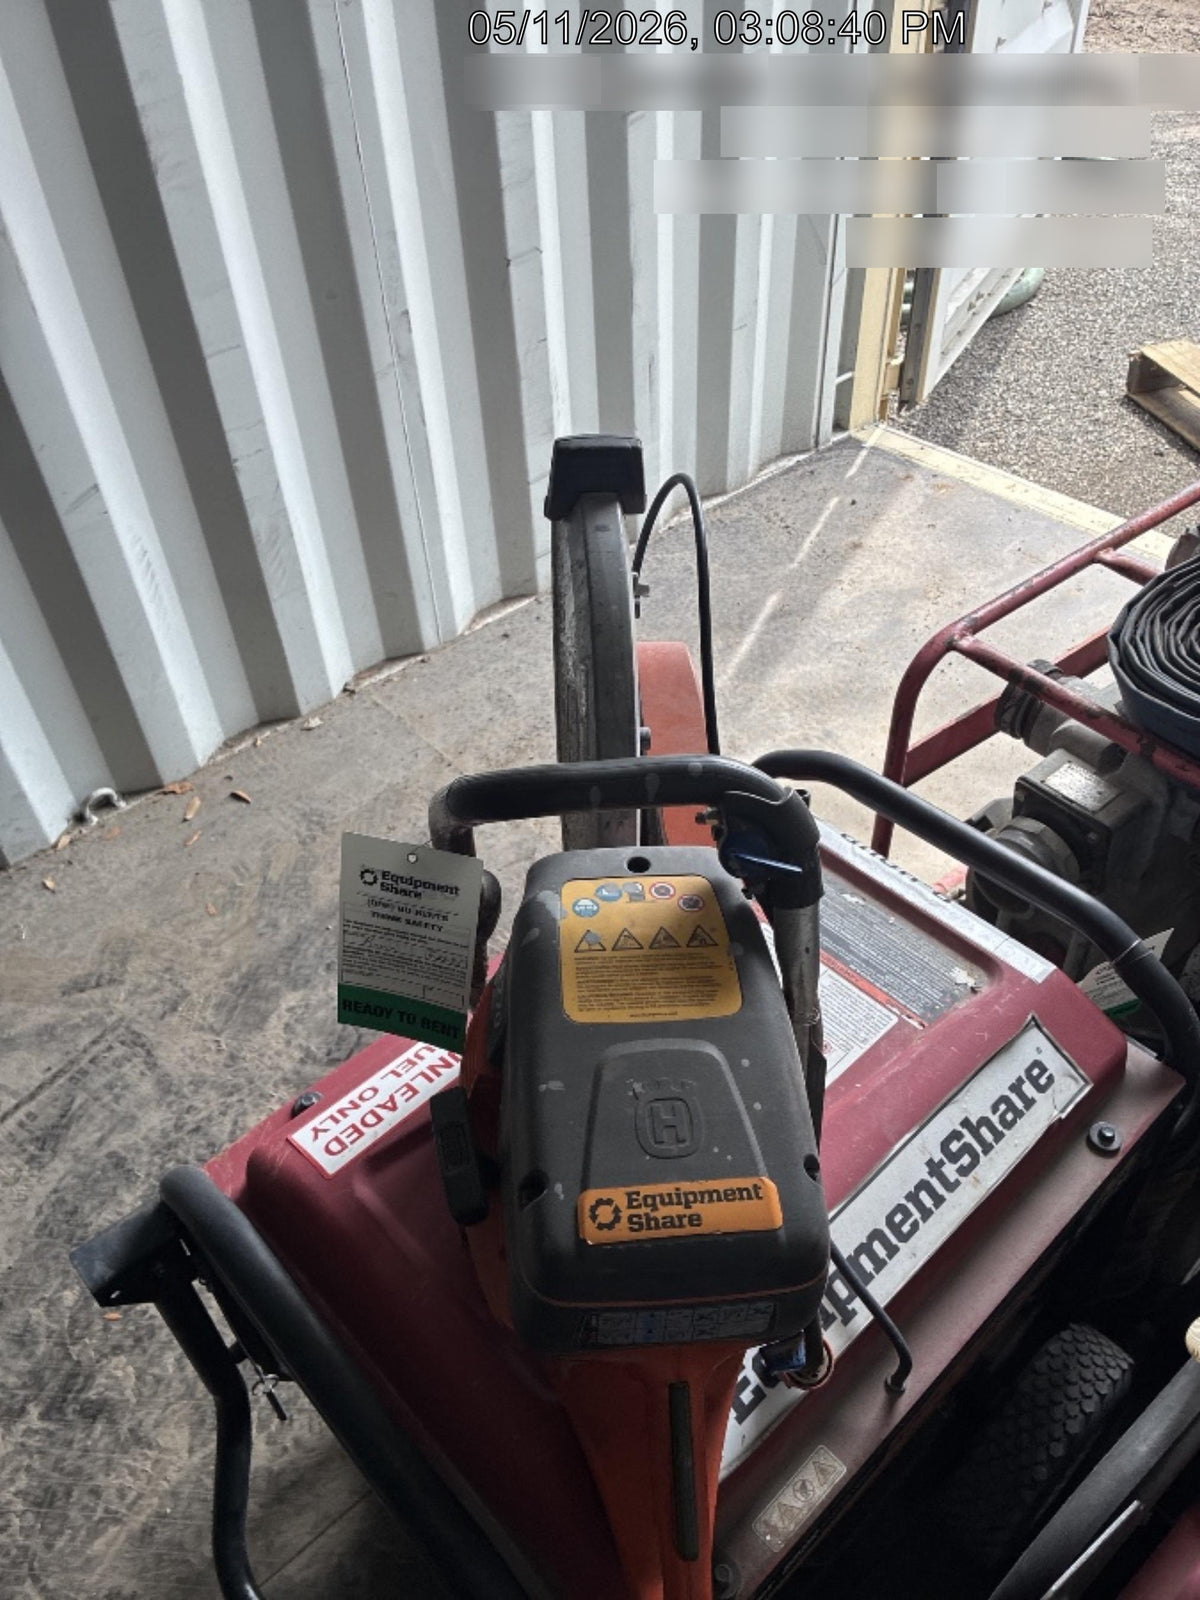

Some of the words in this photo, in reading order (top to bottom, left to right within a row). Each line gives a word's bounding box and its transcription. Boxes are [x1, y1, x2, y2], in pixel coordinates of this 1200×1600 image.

[380, 881, 422, 899] Share
[381, 870, 461, 896] Equipment
[342, 998, 394, 1019] READY
[397, 1010, 416, 1025] TO
[420, 1017, 460, 1039] RENT
[310, 1086, 380, 1142] ONLY
[625, 1184, 764, 1211] Equipment
[627, 1211, 703, 1232] Share
